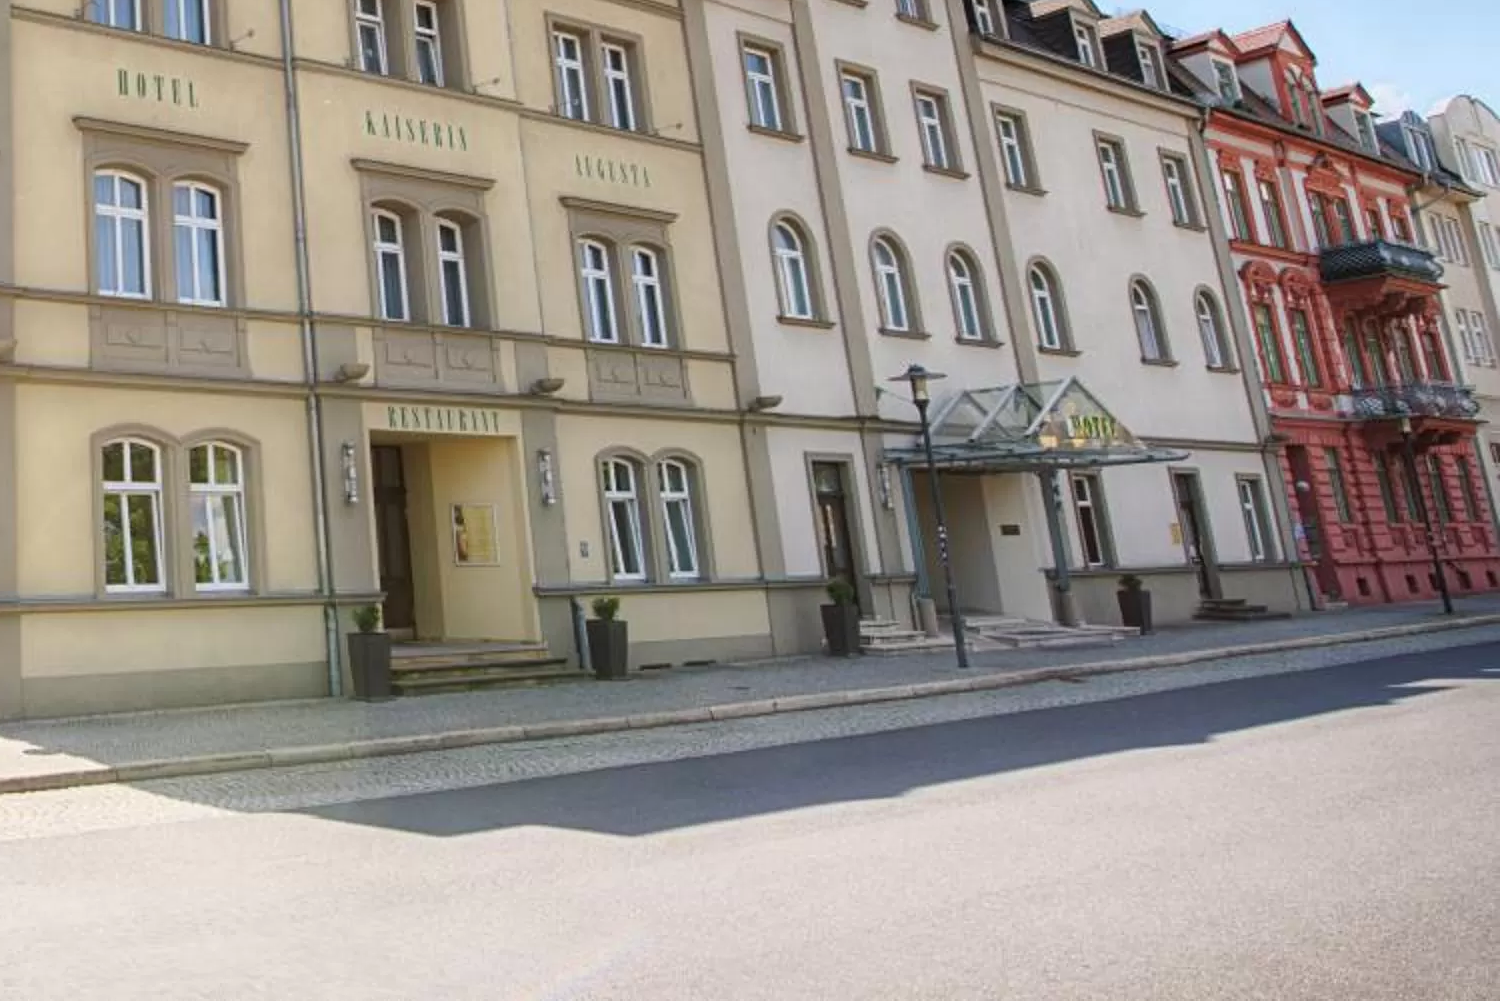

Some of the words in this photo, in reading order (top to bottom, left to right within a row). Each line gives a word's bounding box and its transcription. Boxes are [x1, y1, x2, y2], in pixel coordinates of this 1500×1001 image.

[117, 68, 199, 108] HOTEL
[364, 110, 467, 152] KAISERIN
[575, 153, 652, 188] AUGUSTA
[387, 406, 499, 433] RESTAURANT
